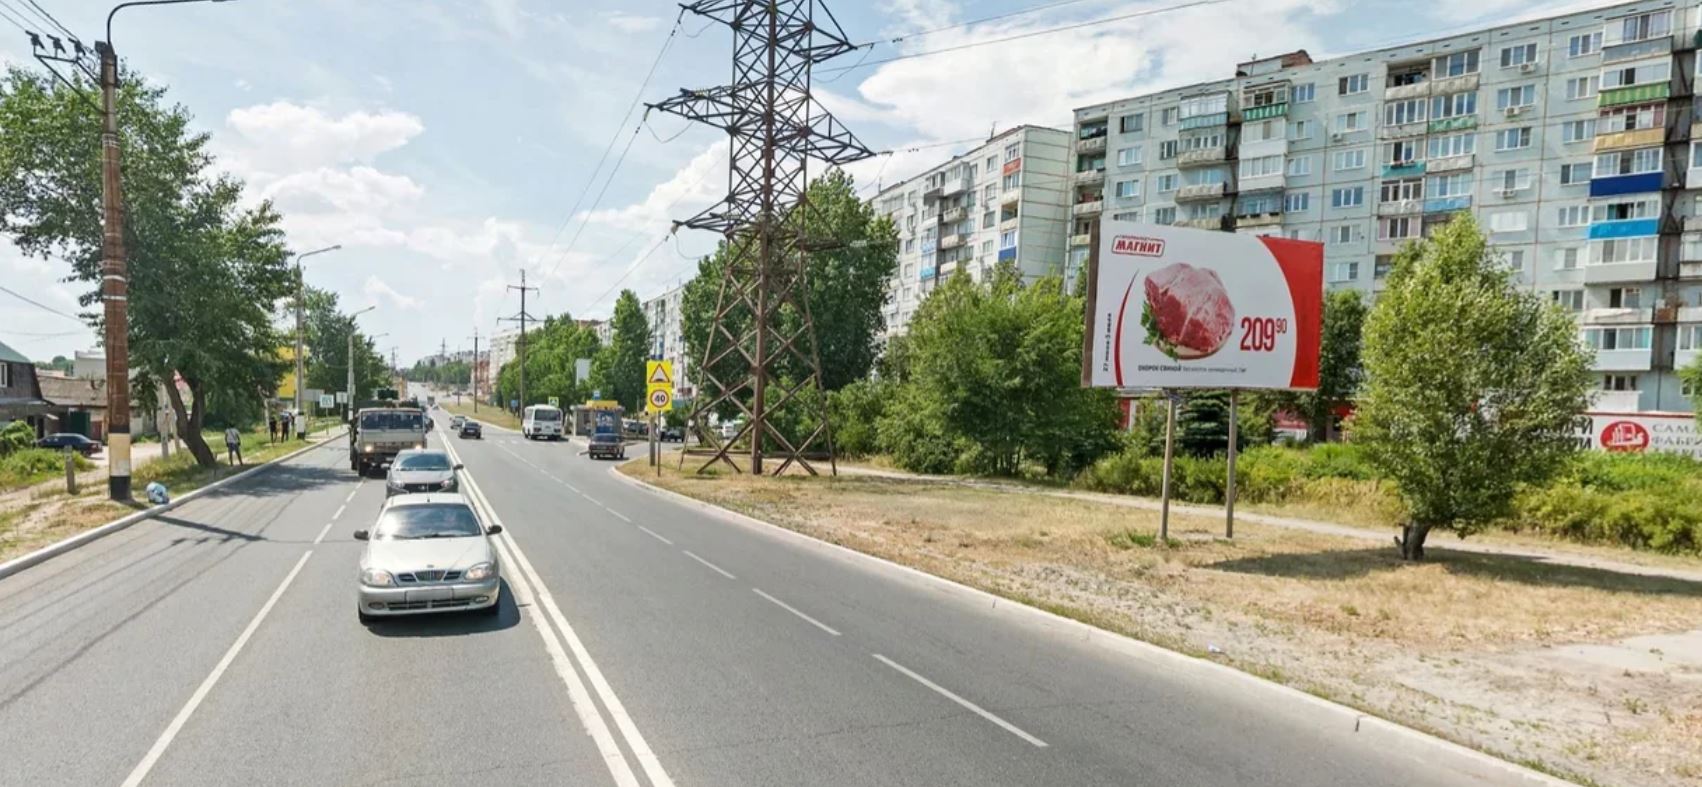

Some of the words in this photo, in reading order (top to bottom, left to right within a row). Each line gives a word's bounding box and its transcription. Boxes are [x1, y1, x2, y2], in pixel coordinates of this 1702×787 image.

[1115, 240, 1161, 253] МАГНИТ
[1240, 317, 1275, 351] 209
[1276, 318, 1287, 334] 90
[654, 394, 666, 403] 40
